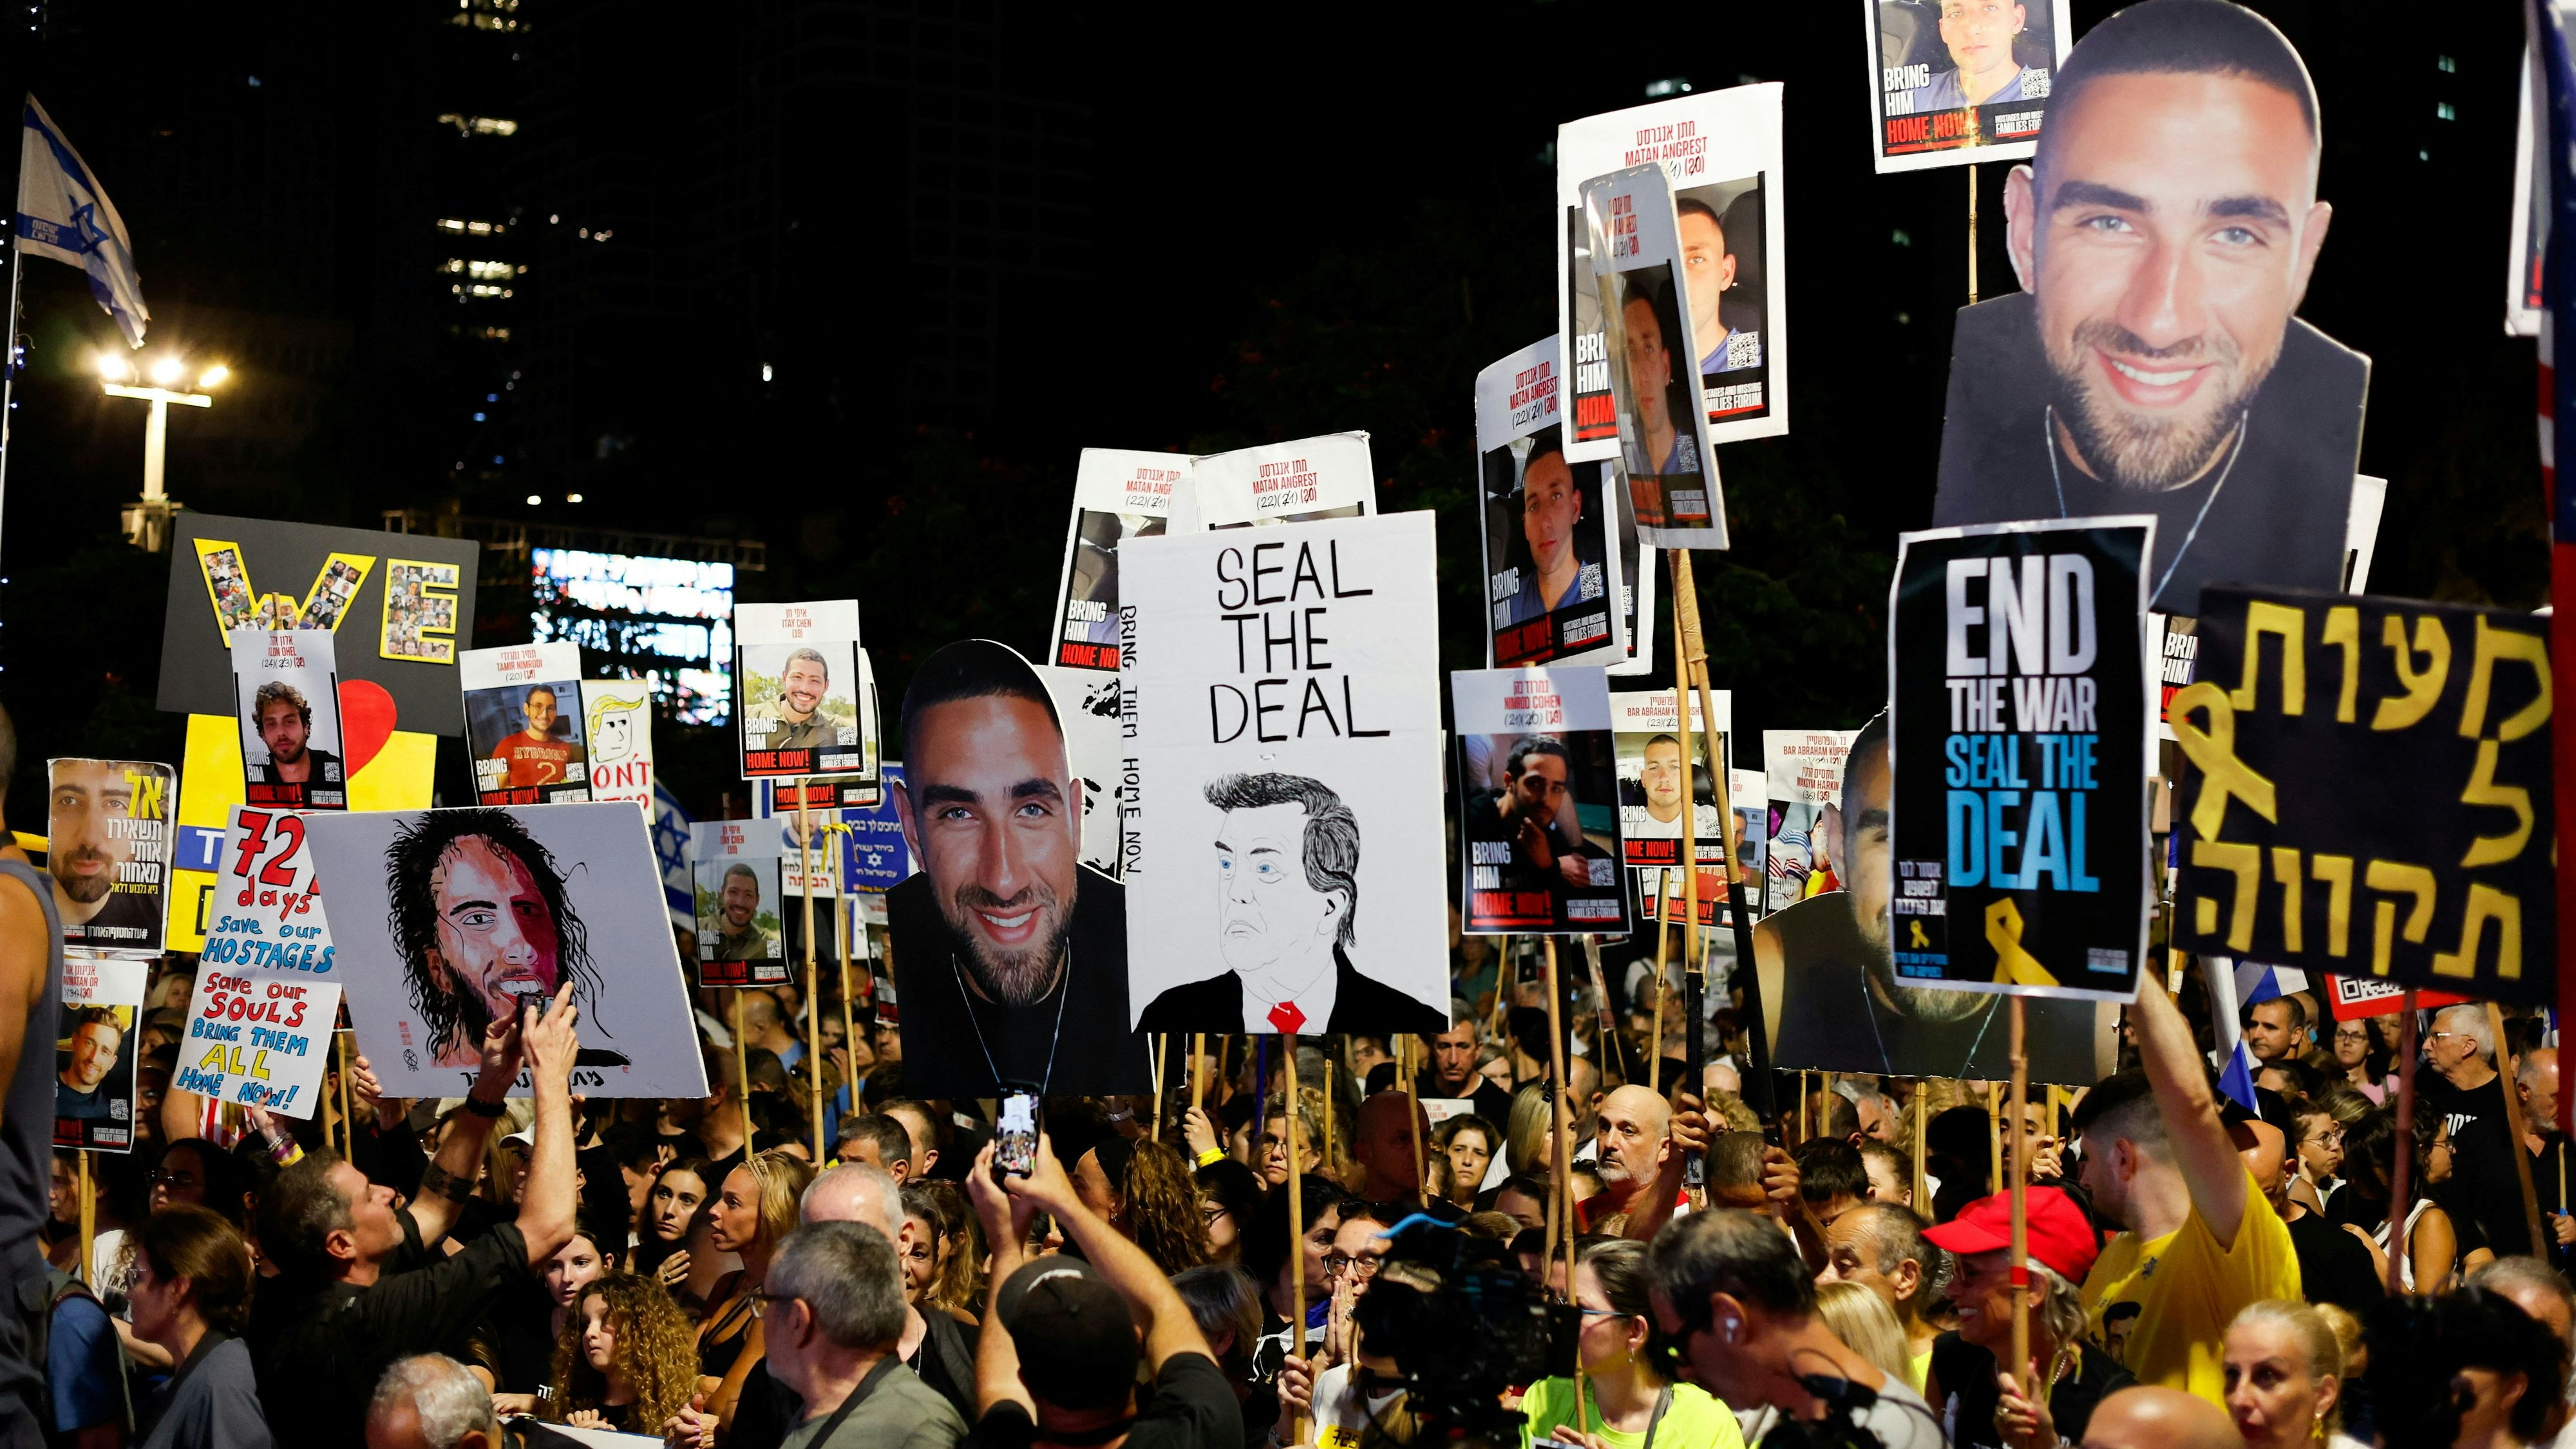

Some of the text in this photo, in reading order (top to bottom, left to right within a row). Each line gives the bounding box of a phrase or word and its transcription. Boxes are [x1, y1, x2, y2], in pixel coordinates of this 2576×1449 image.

[1883, 63, 1930, 91] BRING
[1885, 90, 1915, 117] HIM
[1636, 120, 1695, 146] מתן אנגרסט
[1886, 107, 1979, 143] HOME NOW!
[1996, 120, 2027, 135] FAMILIES
[1625, 137, 1708, 167] MATAN ANGREST
[1576, 332, 1607, 364] BRI
[1515, 361, 1550, 390] מתן אנגרסט
[1577, 362, 1609, 393] HIM
[1510, 375, 1558, 411] MATAN ANGREST
[1725, 381, 1762, 396] AND MISSING
[1733, 391, 1763, 409] FORUM
[1577, 394, 1615, 427] HOM
[1137, 468, 1164, 481] אנגרסט
[1259, 459, 1307, 478] מתן אנגרסט
[1126, 480, 1151, 493] MATAN
[1253, 472, 1317, 495] MATAN ANGREST
[1217, 540, 1373, 611] SEAL
[1492, 566, 1519, 602] BRING
[193, 538, 459, 664] WE
[1068, 598, 1107, 623] BRING
[782, 619, 811, 628] ITAY CHEN
[1494, 601, 1512, 631] HIM
[1946, 553, 2098, 676] END
[792, 629, 803, 639] (19)
[1064, 620, 1091, 643] HIM
[1221, 607, 1332, 674] THE
[1564, 621, 1607, 645] FAMILIES FORUM
[281, 647, 297, 656] OHEL
[1061, 643, 1097, 666] HOME
[497, 659, 543, 672] TAMIR NIMRODI
[506, 672, 522, 682] (20)
[2161, 658, 2188, 685] HIM
[1210, 674, 1390, 744] DEAL
[1504, 695, 1561, 710] NIMROD COHEN
[1627, 707, 1670, 717] BAR ABRAHAM
[1946, 678, 2006, 732] THE
[2012, 677, 2098, 732] WAR
[744, 717, 778, 734] BRING
[746, 734, 766, 750] HIM
[1119, 605, 1142, 873] BRING THEM HOME NOW
[1783, 746, 1828, 755] BAR ABRAHAM
[245, 750, 270, 766] BRING
[476, 757, 507, 776] BRING
[746, 748, 810, 769] HOME NOW!
[820, 757, 860, 768] FAMILIES FORUM
[1946, 735, 2098, 789] SEAL THE
[247, 764, 265, 782] HIM
[478, 774, 499, 792] HIM
[592, 754, 650, 789] ON'T
[1814, 768, 1834, 781] מקסים
[124, 770, 164, 819] אל
[249, 785, 276, 801] HOME
[481, 791, 509, 806] HOME
[511, 786, 540, 805] NOW!
[777, 784, 835, 804] HOM NOW!
[1803, 790, 1815, 802] (36)
[1817, 780, 1839, 791] HARKIN
[108, 819, 162, 840] תשאירו
[130, 840, 161, 862] אותי
[234, 810, 320, 896] 72
[1472, 841, 1511, 865] BRING
[1646, 840, 1674, 857] NOW!
[1946, 790, 2100, 893] DEAL
[117, 862, 160, 884] מאחור
[1473, 866, 1500, 889] HIM
[110, 882, 158, 895] גיא גלבוע דלאל
[238, 875, 313, 922] days
[1473, 891, 1514, 916] HOME
[1567, 907, 1620, 918] FAMILIES FORUM
[2192, 838, 2522, 980] תקווה
[698, 929, 720, 945] BRING
[202, 938, 336, 973] HOSTAGES
[90, 976, 98, 987] OR
[203, 992, 308, 1028] SOULS
[191, 1018, 309, 1056] BRING THEM
[199, 1043, 270, 1081] ALL
[176, 1066, 300, 1110] HOME NOW!
